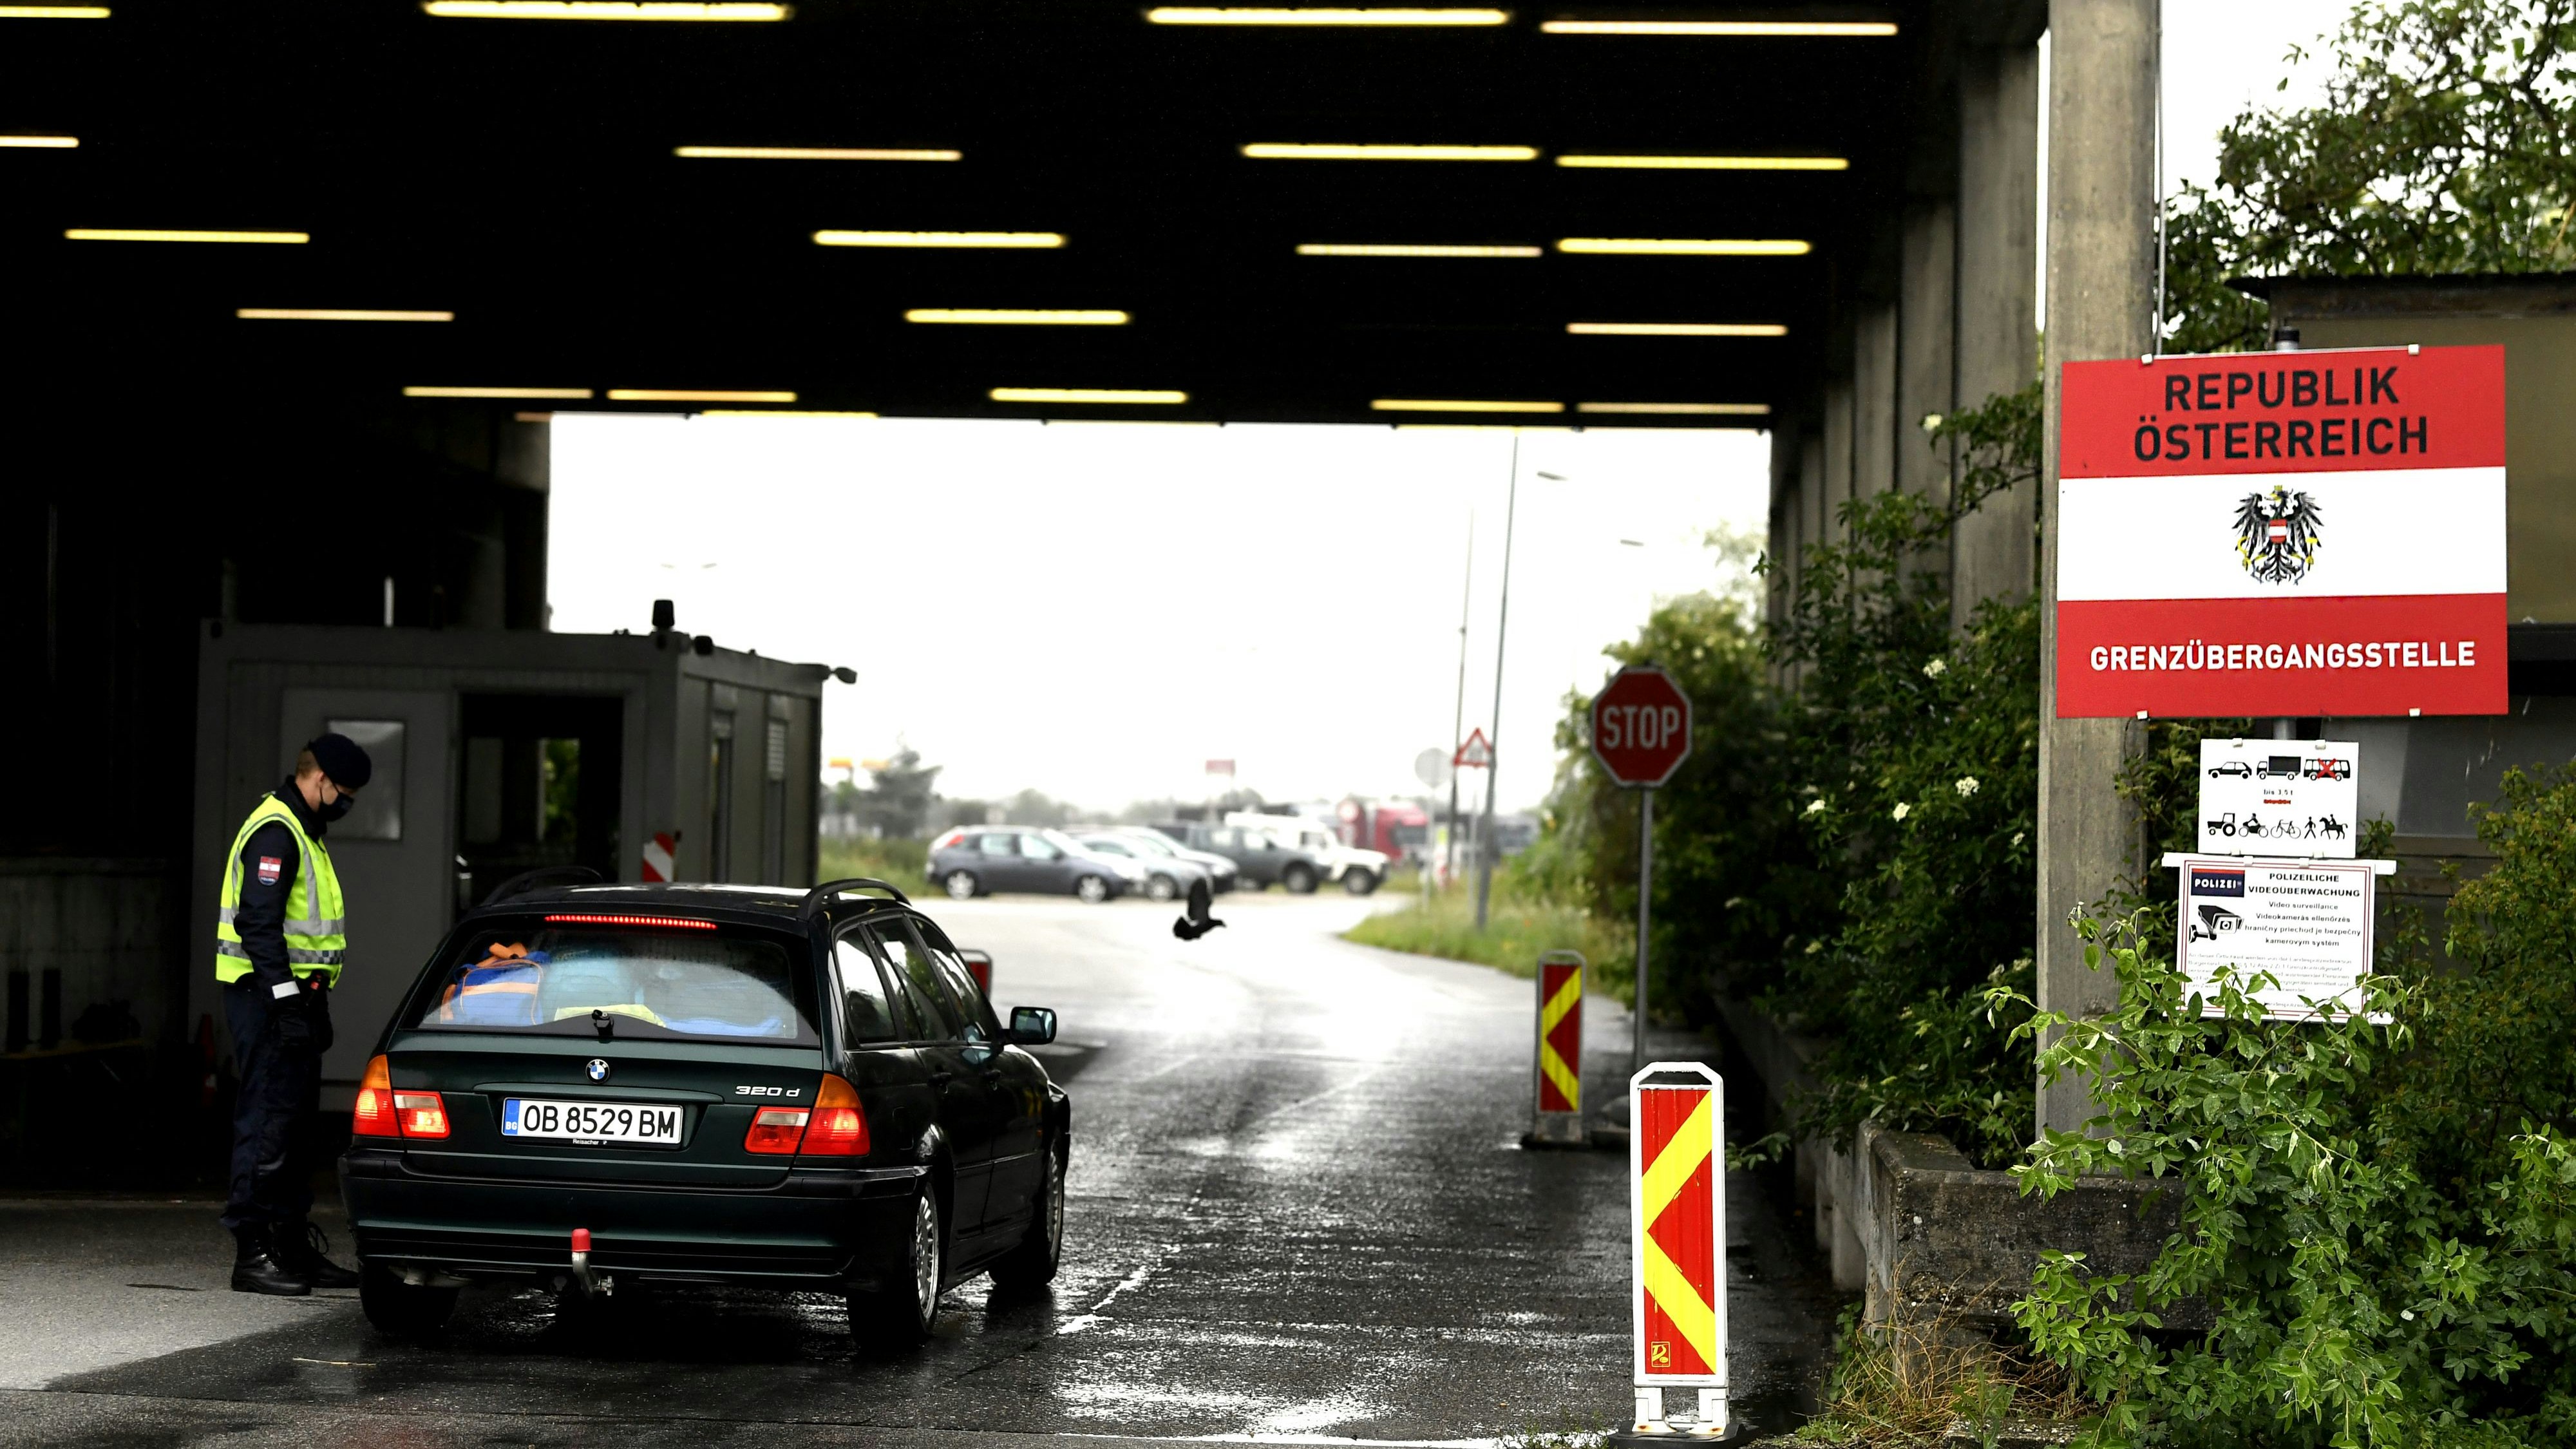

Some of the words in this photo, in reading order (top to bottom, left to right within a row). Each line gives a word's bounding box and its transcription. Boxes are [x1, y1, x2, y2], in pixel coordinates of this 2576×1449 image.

[2164, 366, 2399, 412] REPUBLIK
[2134, 415, 2428, 462] ÖSTERREICH
[2090, 639, 2476, 672] GRENZÜBERGANGSSTELLE
[1601, 705, 1681, 750] STOP
[2194, 878, 2237, 889] POLIZEI
[2269, 873, 2340, 882] POLIZEILICHE
[2248, 886, 2360, 897] VIDEOÜBERWACHUNG
[735, 1086, 782, 1096] 320
[786, 1088, 800, 1097] d
[506, 1121, 518, 1130] BG
[524, 1105, 558, 1132] OB
[565, 1106, 632, 1135] 8529
[639, 1110, 676, 1138] BM
